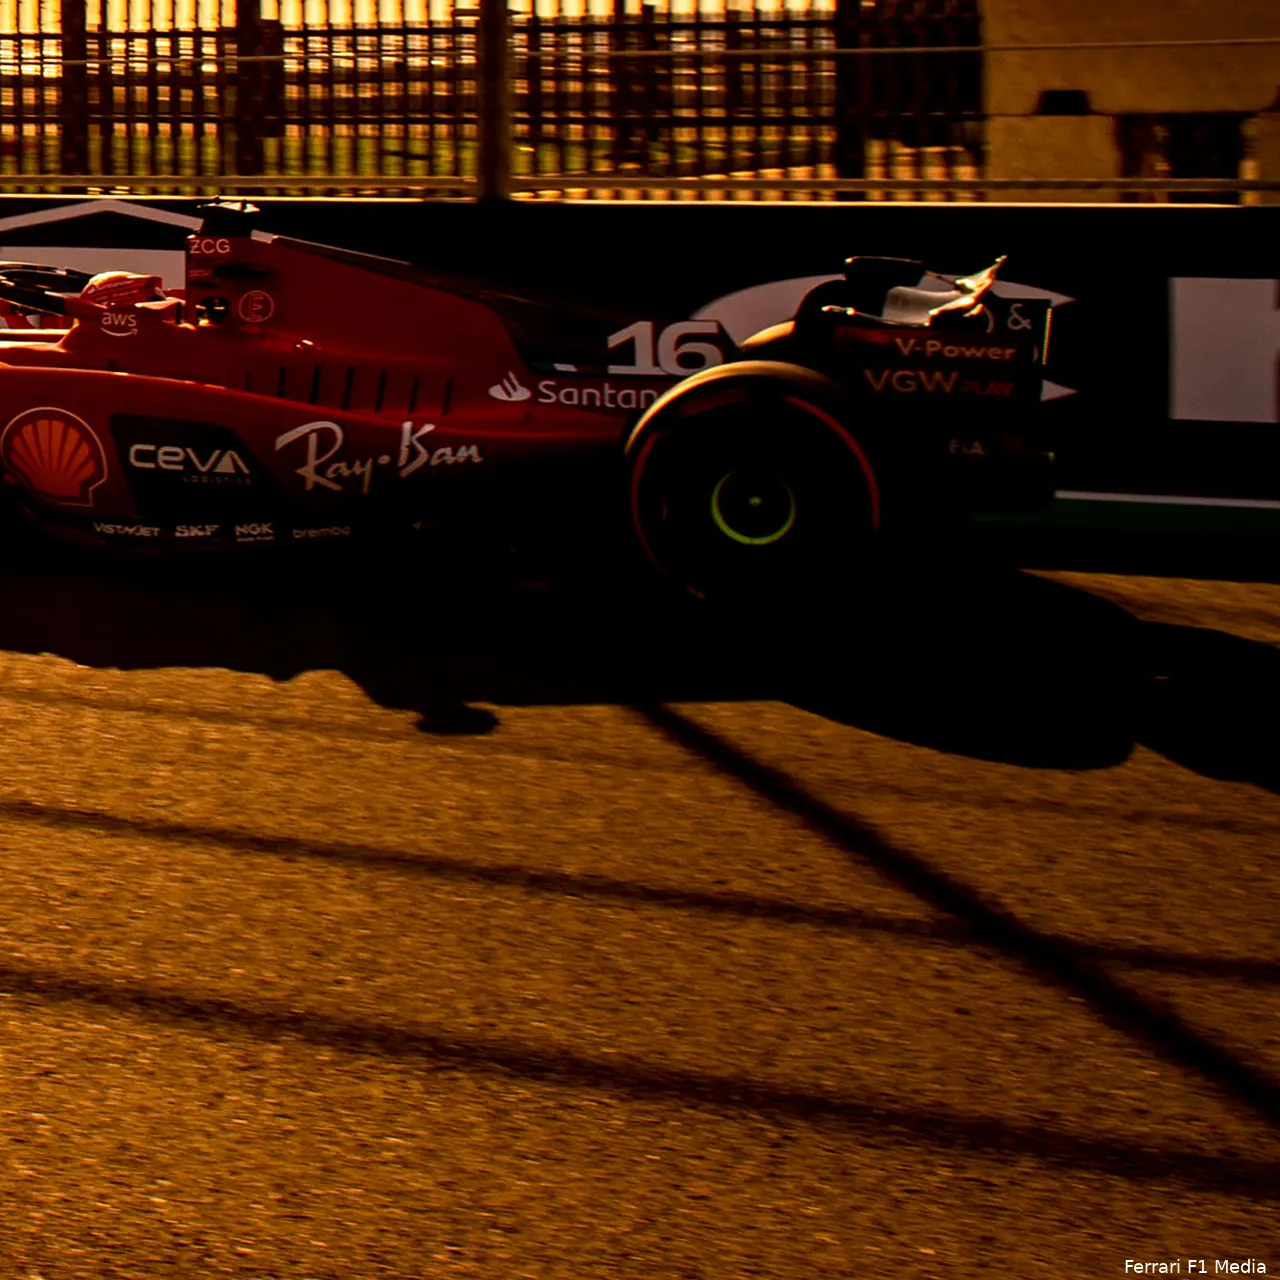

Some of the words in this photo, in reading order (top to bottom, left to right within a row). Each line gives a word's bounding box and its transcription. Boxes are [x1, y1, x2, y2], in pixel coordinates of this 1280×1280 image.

[101, 311, 137, 327] aws
[607, 320, 724, 377] 16
[895, 337, 1017, 360] V-Power
[863, 369, 959, 394] VGW
[173, 524, 221, 538] SKF
[234, 522, 275, 537] NGK
